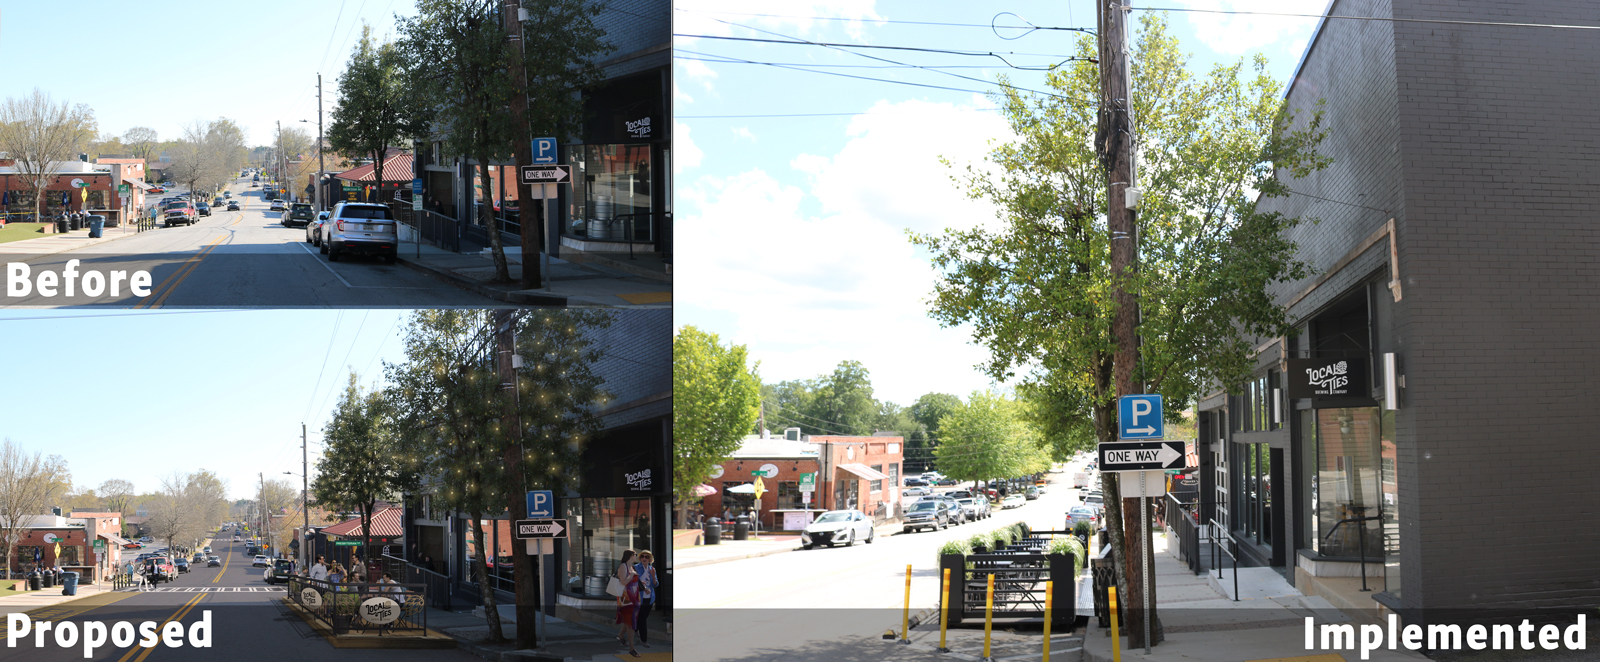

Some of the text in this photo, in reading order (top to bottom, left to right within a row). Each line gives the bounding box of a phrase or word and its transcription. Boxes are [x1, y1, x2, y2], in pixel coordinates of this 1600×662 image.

[625, 119, 651, 132] LOCAL
[635, 126, 651, 138] TIES
[538, 140, 551, 157] P
[541, 170, 556, 178] WAY
[1306, 363, 1348, 385] LOCAL
[1321, 375, 1349, 395] TIES
[1131, 399, 1152, 426] P
[1108, 450, 1160, 462] ONE WAY
[625, 470, 652, 484] LOCAL
[635, 478, 652, 491] TIES
[534, 493, 547, 511] P
[537, 525, 551, 533] WAY
[365, 602, 391, 615] LOCAL
[375, 609, 392, 621] TIES
